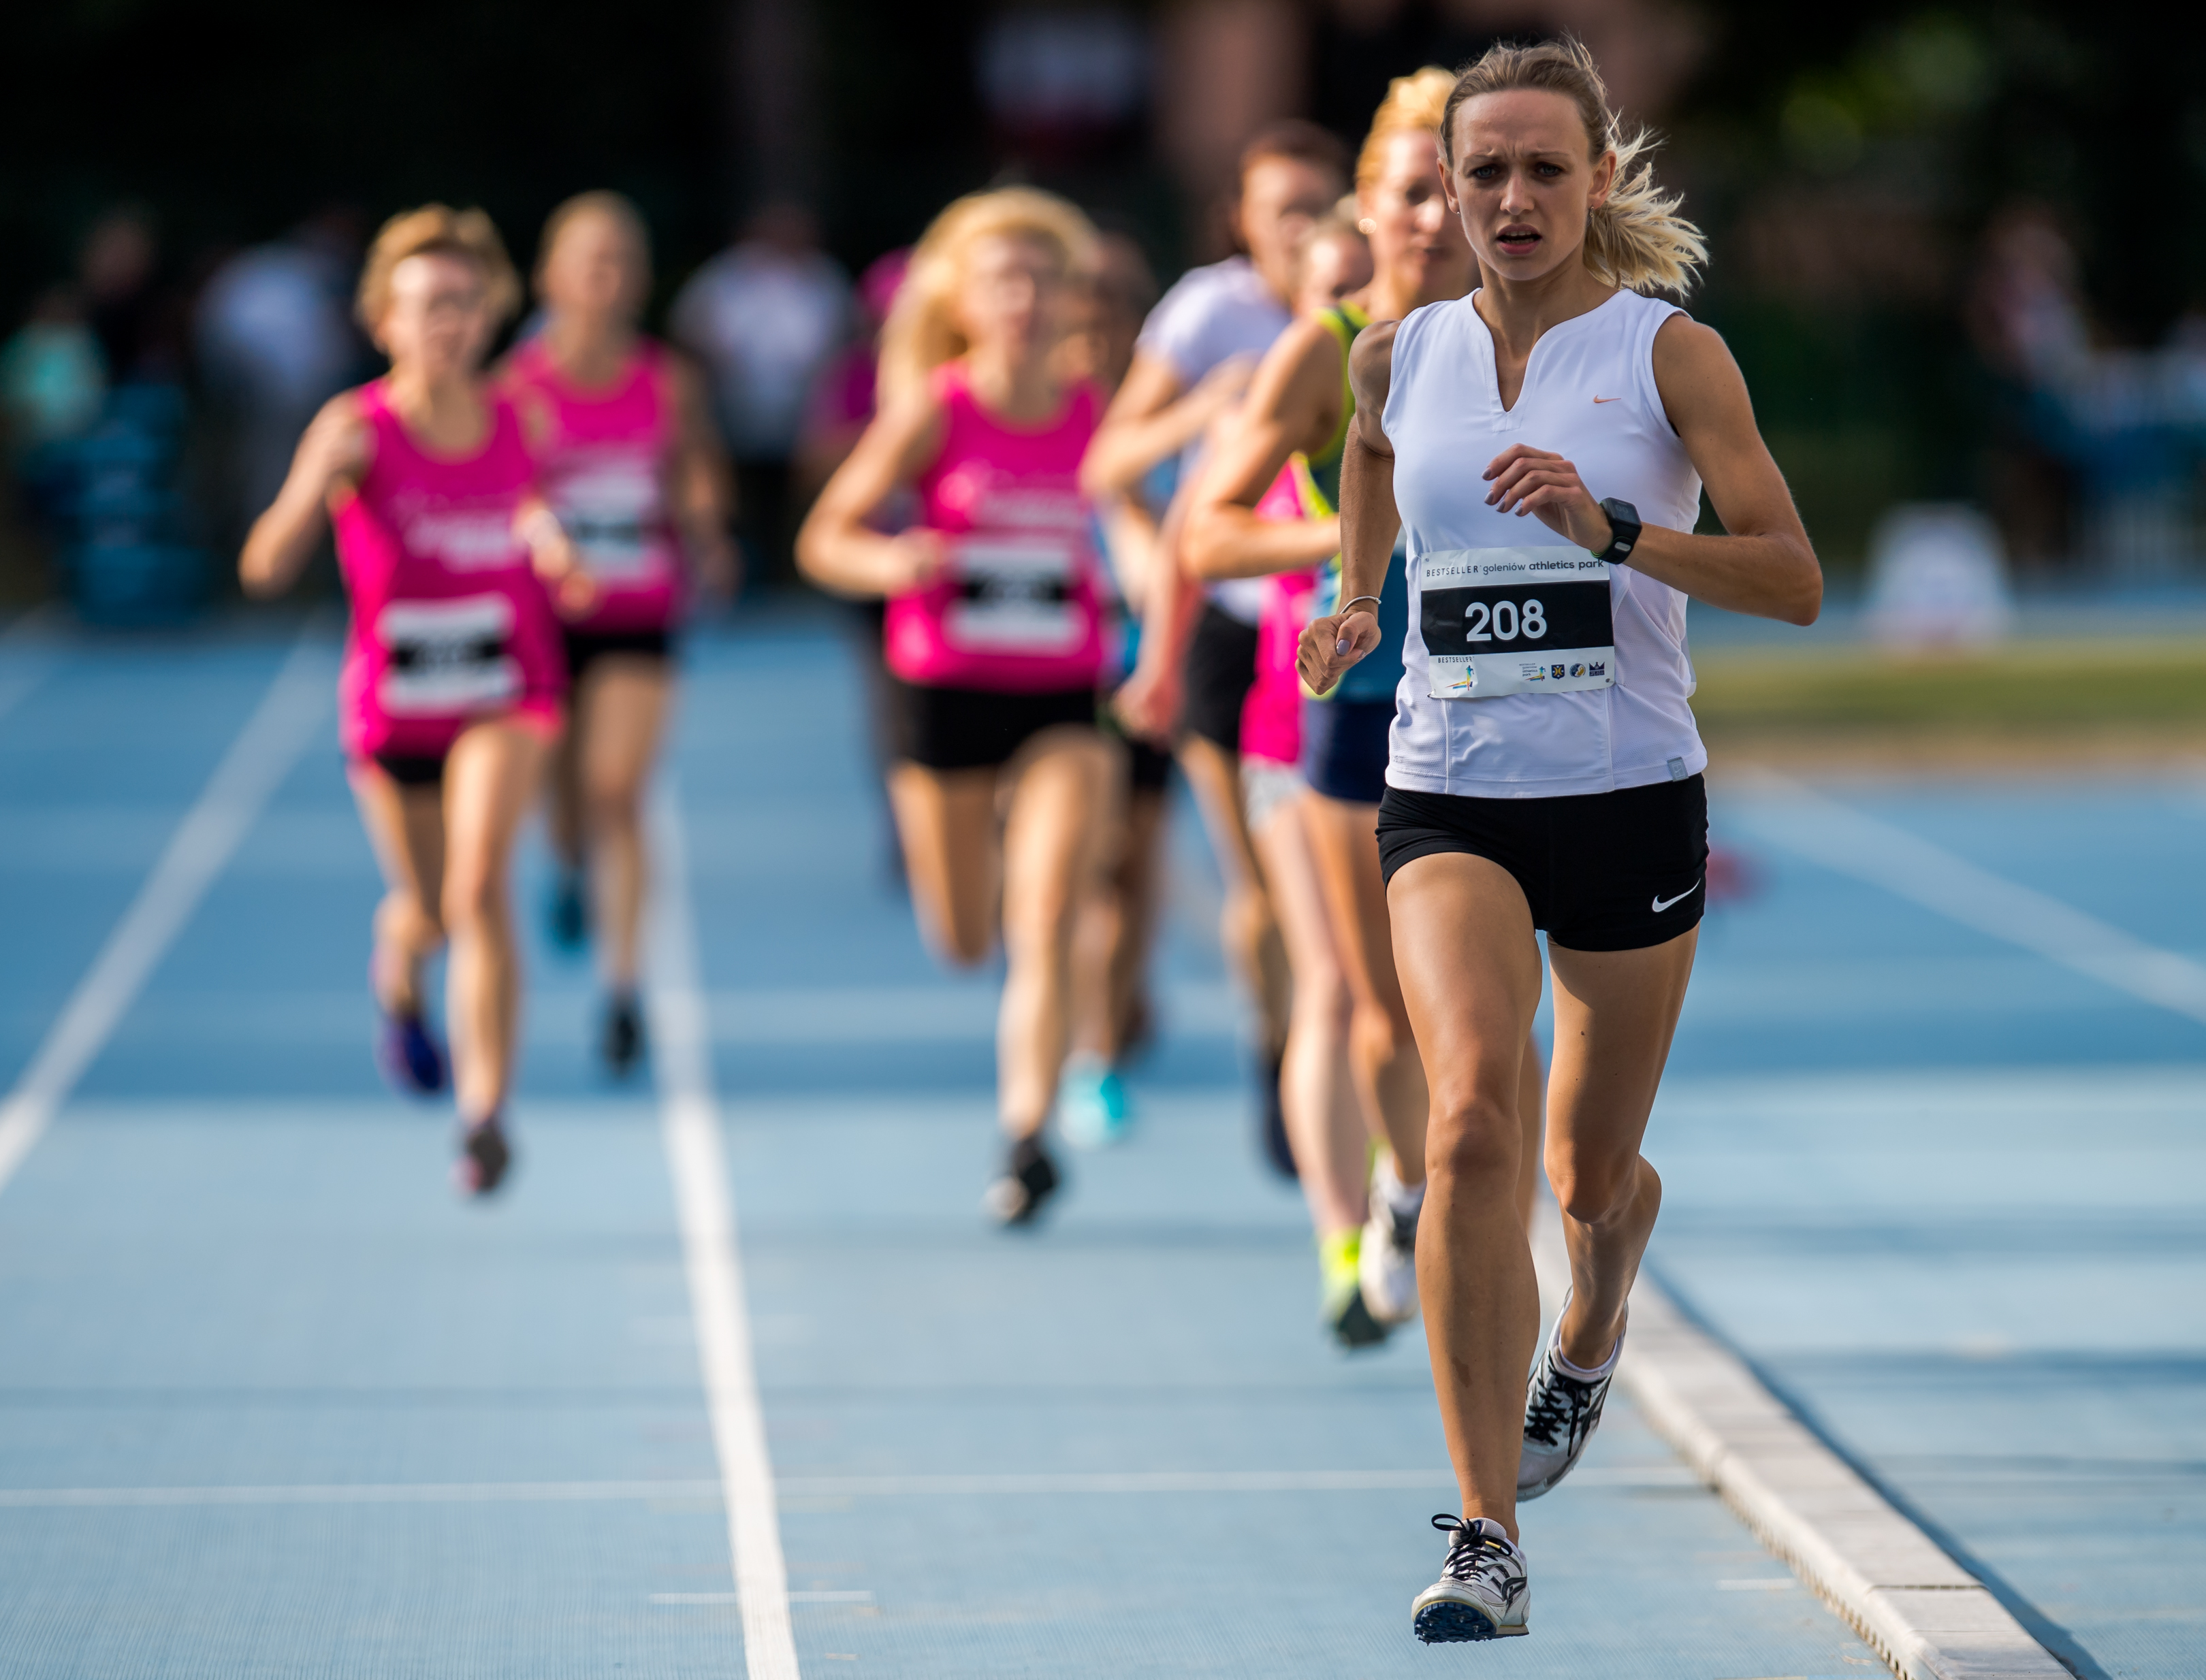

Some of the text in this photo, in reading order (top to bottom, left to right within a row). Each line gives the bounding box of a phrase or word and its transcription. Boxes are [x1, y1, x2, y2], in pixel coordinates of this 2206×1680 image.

[1426, 559, 1604, 577] BESTSELLER goleniów athletics park
[1465, 599, 1547, 642] 208
